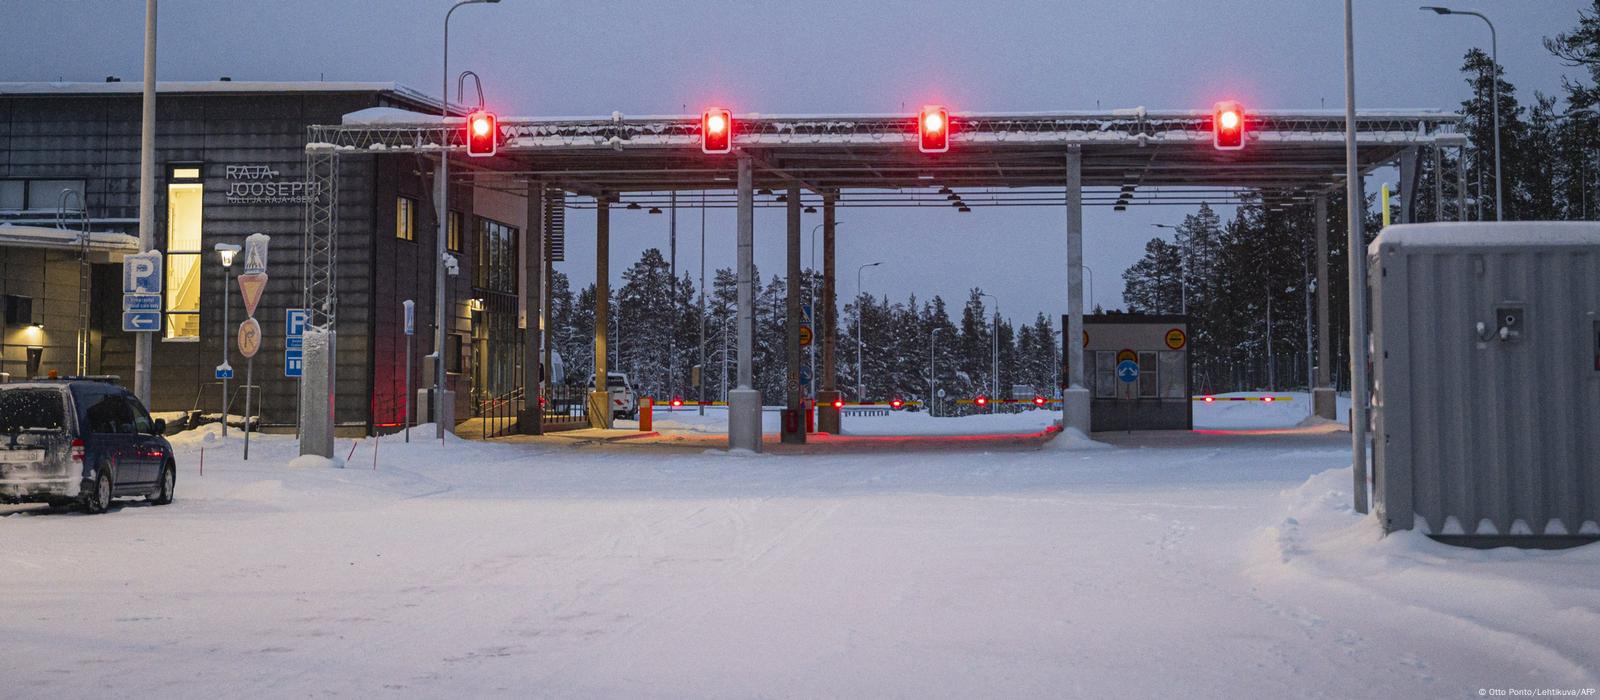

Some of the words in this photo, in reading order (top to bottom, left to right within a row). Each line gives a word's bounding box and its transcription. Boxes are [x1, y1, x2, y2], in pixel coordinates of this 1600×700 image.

[226, 165, 279, 179] RAJA-
[226, 182, 321, 196] JOOSEPPI
[226, 196, 249, 204] TULLI
[251, 196, 261, 204] JA
[130, 258, 154, 291] P
